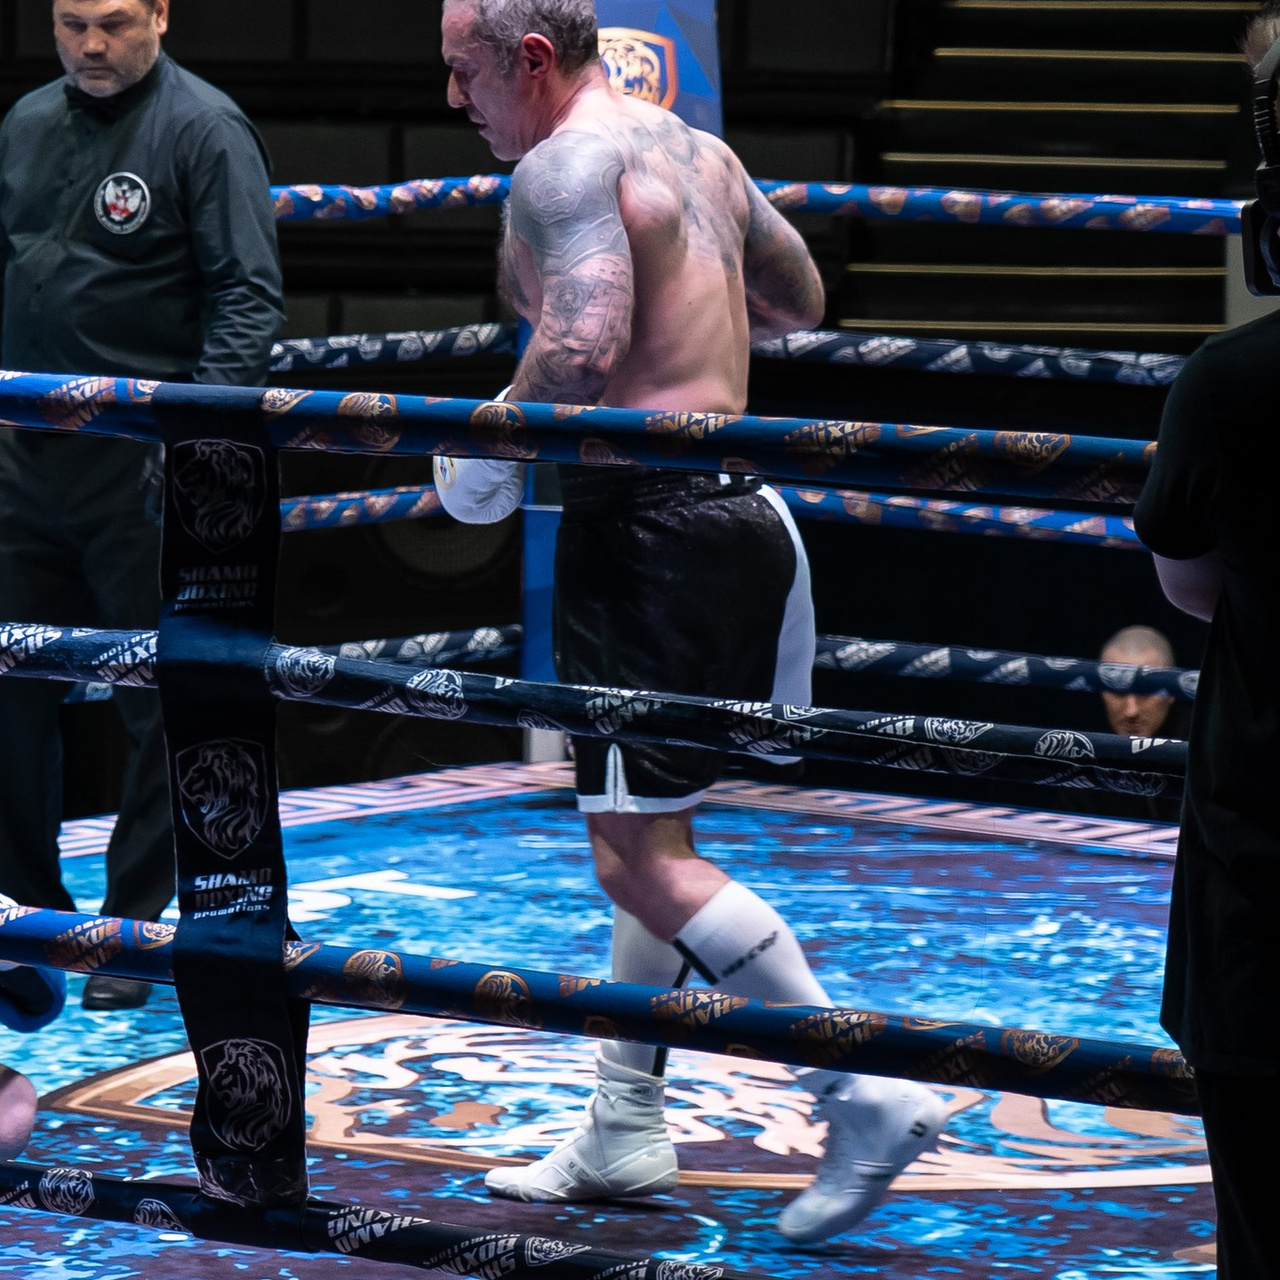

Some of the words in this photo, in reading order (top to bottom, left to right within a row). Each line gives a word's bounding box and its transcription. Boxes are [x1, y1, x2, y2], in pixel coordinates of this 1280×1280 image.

[194, 868, 273, 892] SHAMO
[193, 885, 274, 910] BOXING
[193, 902, 271, 921] promotions
